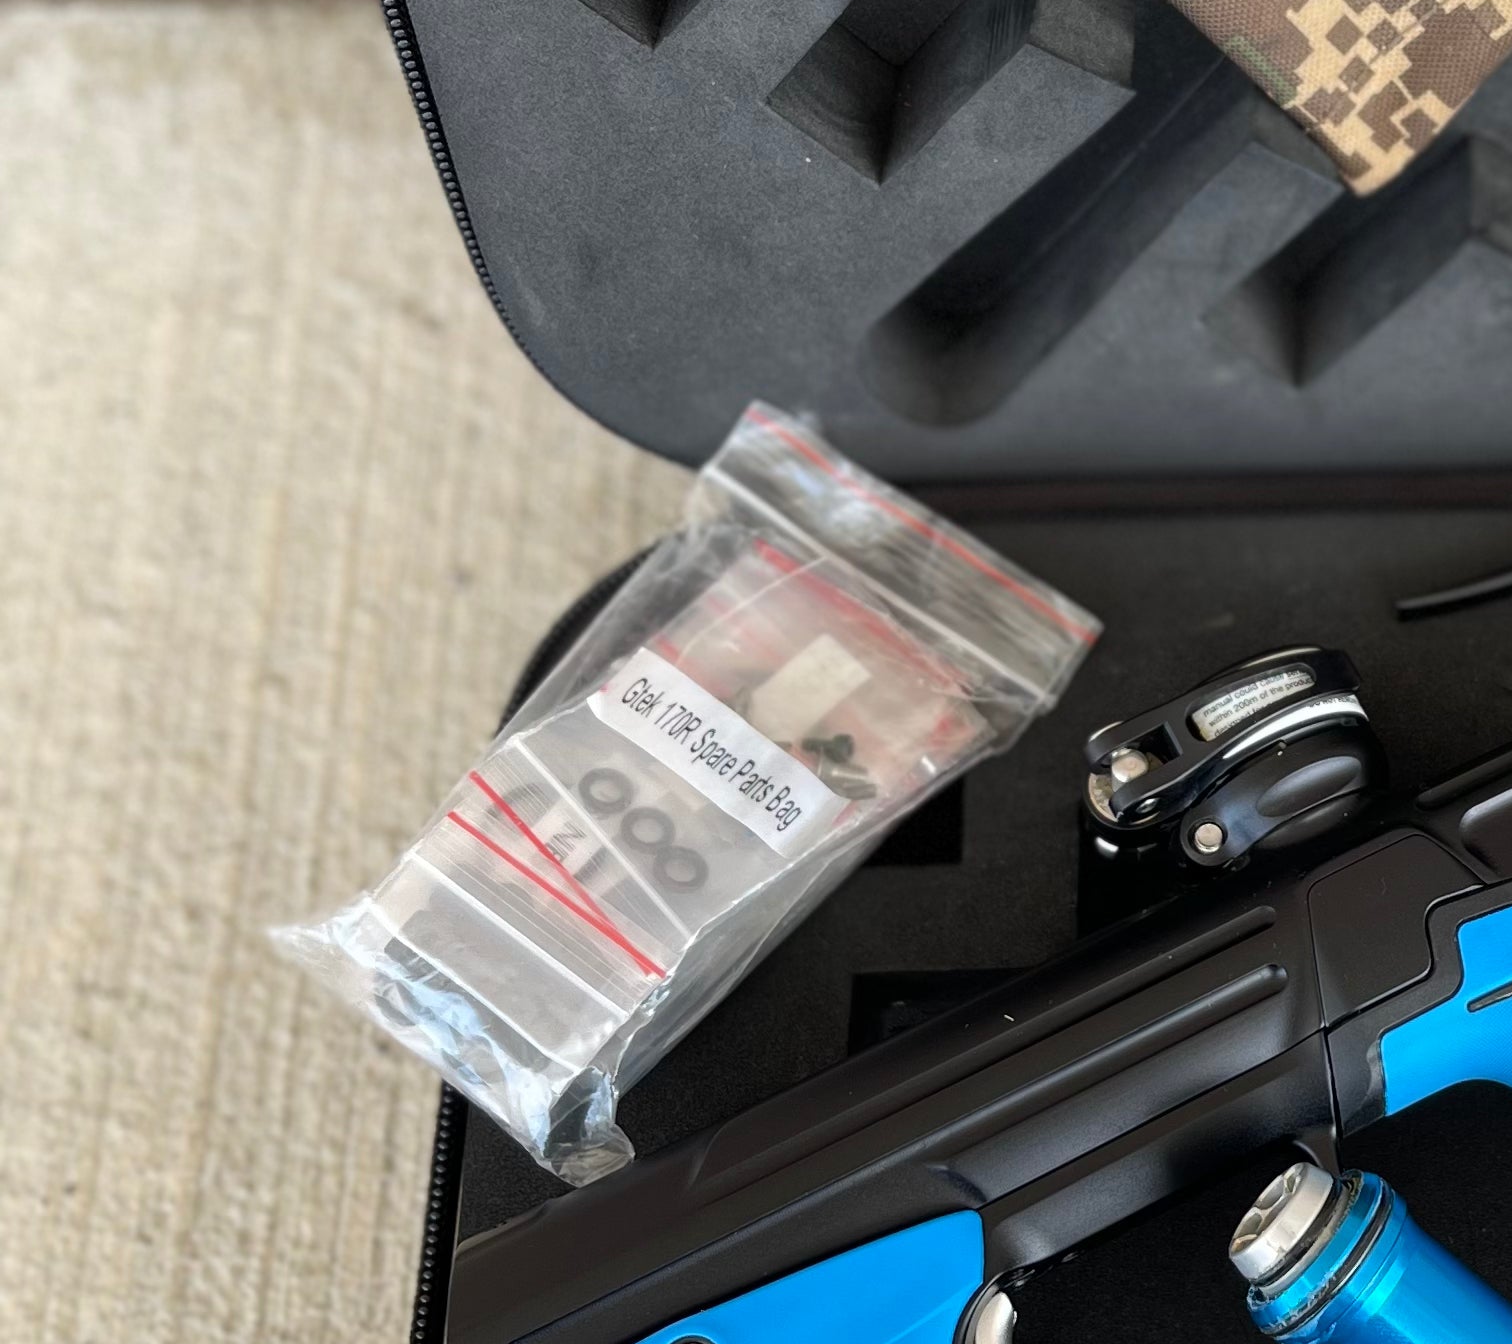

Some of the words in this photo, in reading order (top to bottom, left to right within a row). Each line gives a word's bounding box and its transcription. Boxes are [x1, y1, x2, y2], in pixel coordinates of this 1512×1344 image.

[621, 678, 664, 718] Gtek
[654, 702, 702, 745] 170R
[690, 728, 737, 775] Spare
[728, 759, 774, 802] Parts
[765, 786, 802, 831] Bag
